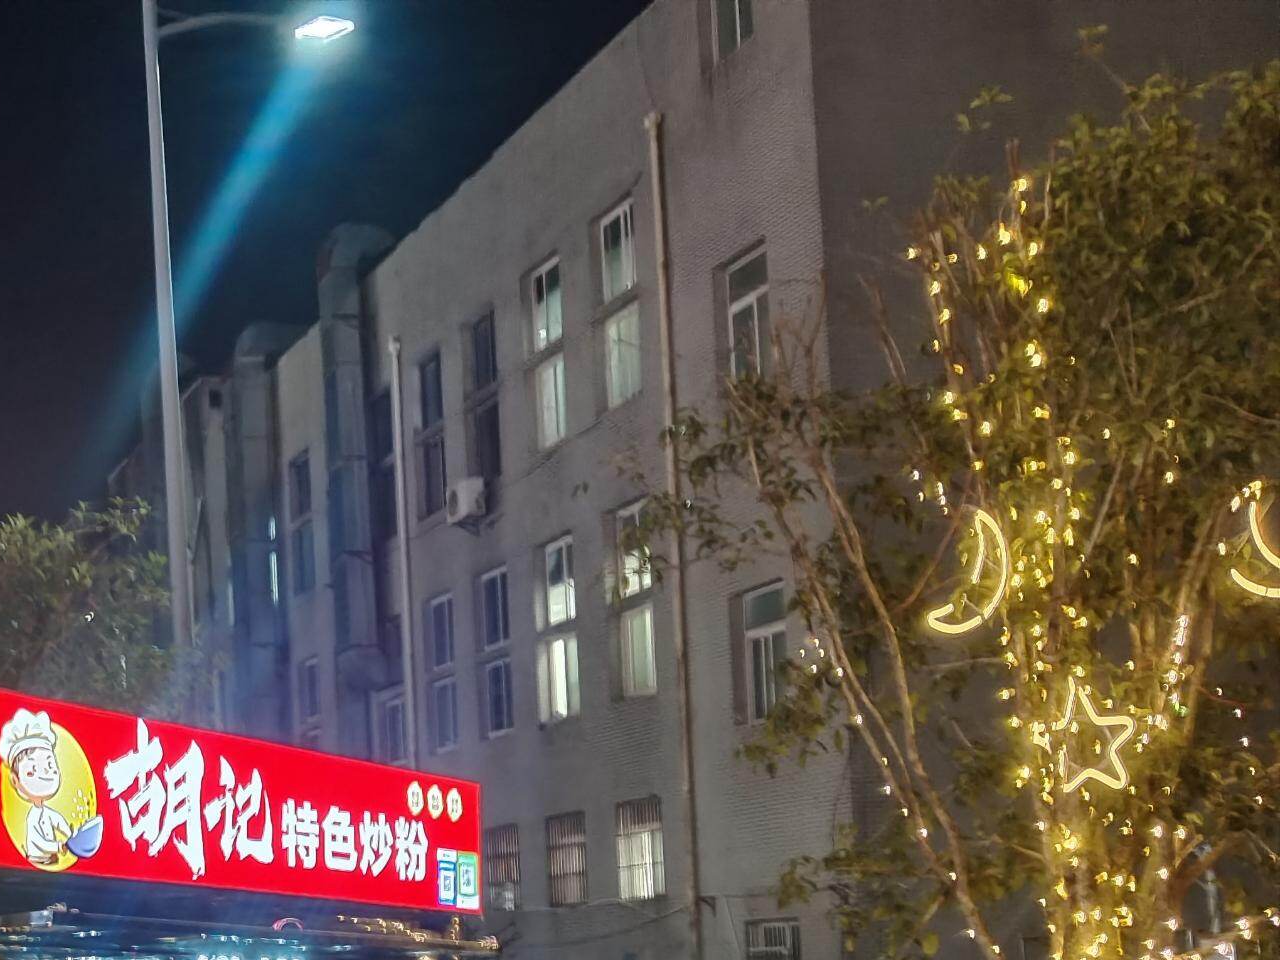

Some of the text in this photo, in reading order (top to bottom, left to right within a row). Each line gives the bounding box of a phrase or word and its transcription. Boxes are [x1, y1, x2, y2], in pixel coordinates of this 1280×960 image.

[103, 717, 429, 882] 胡记 特色炒粉
